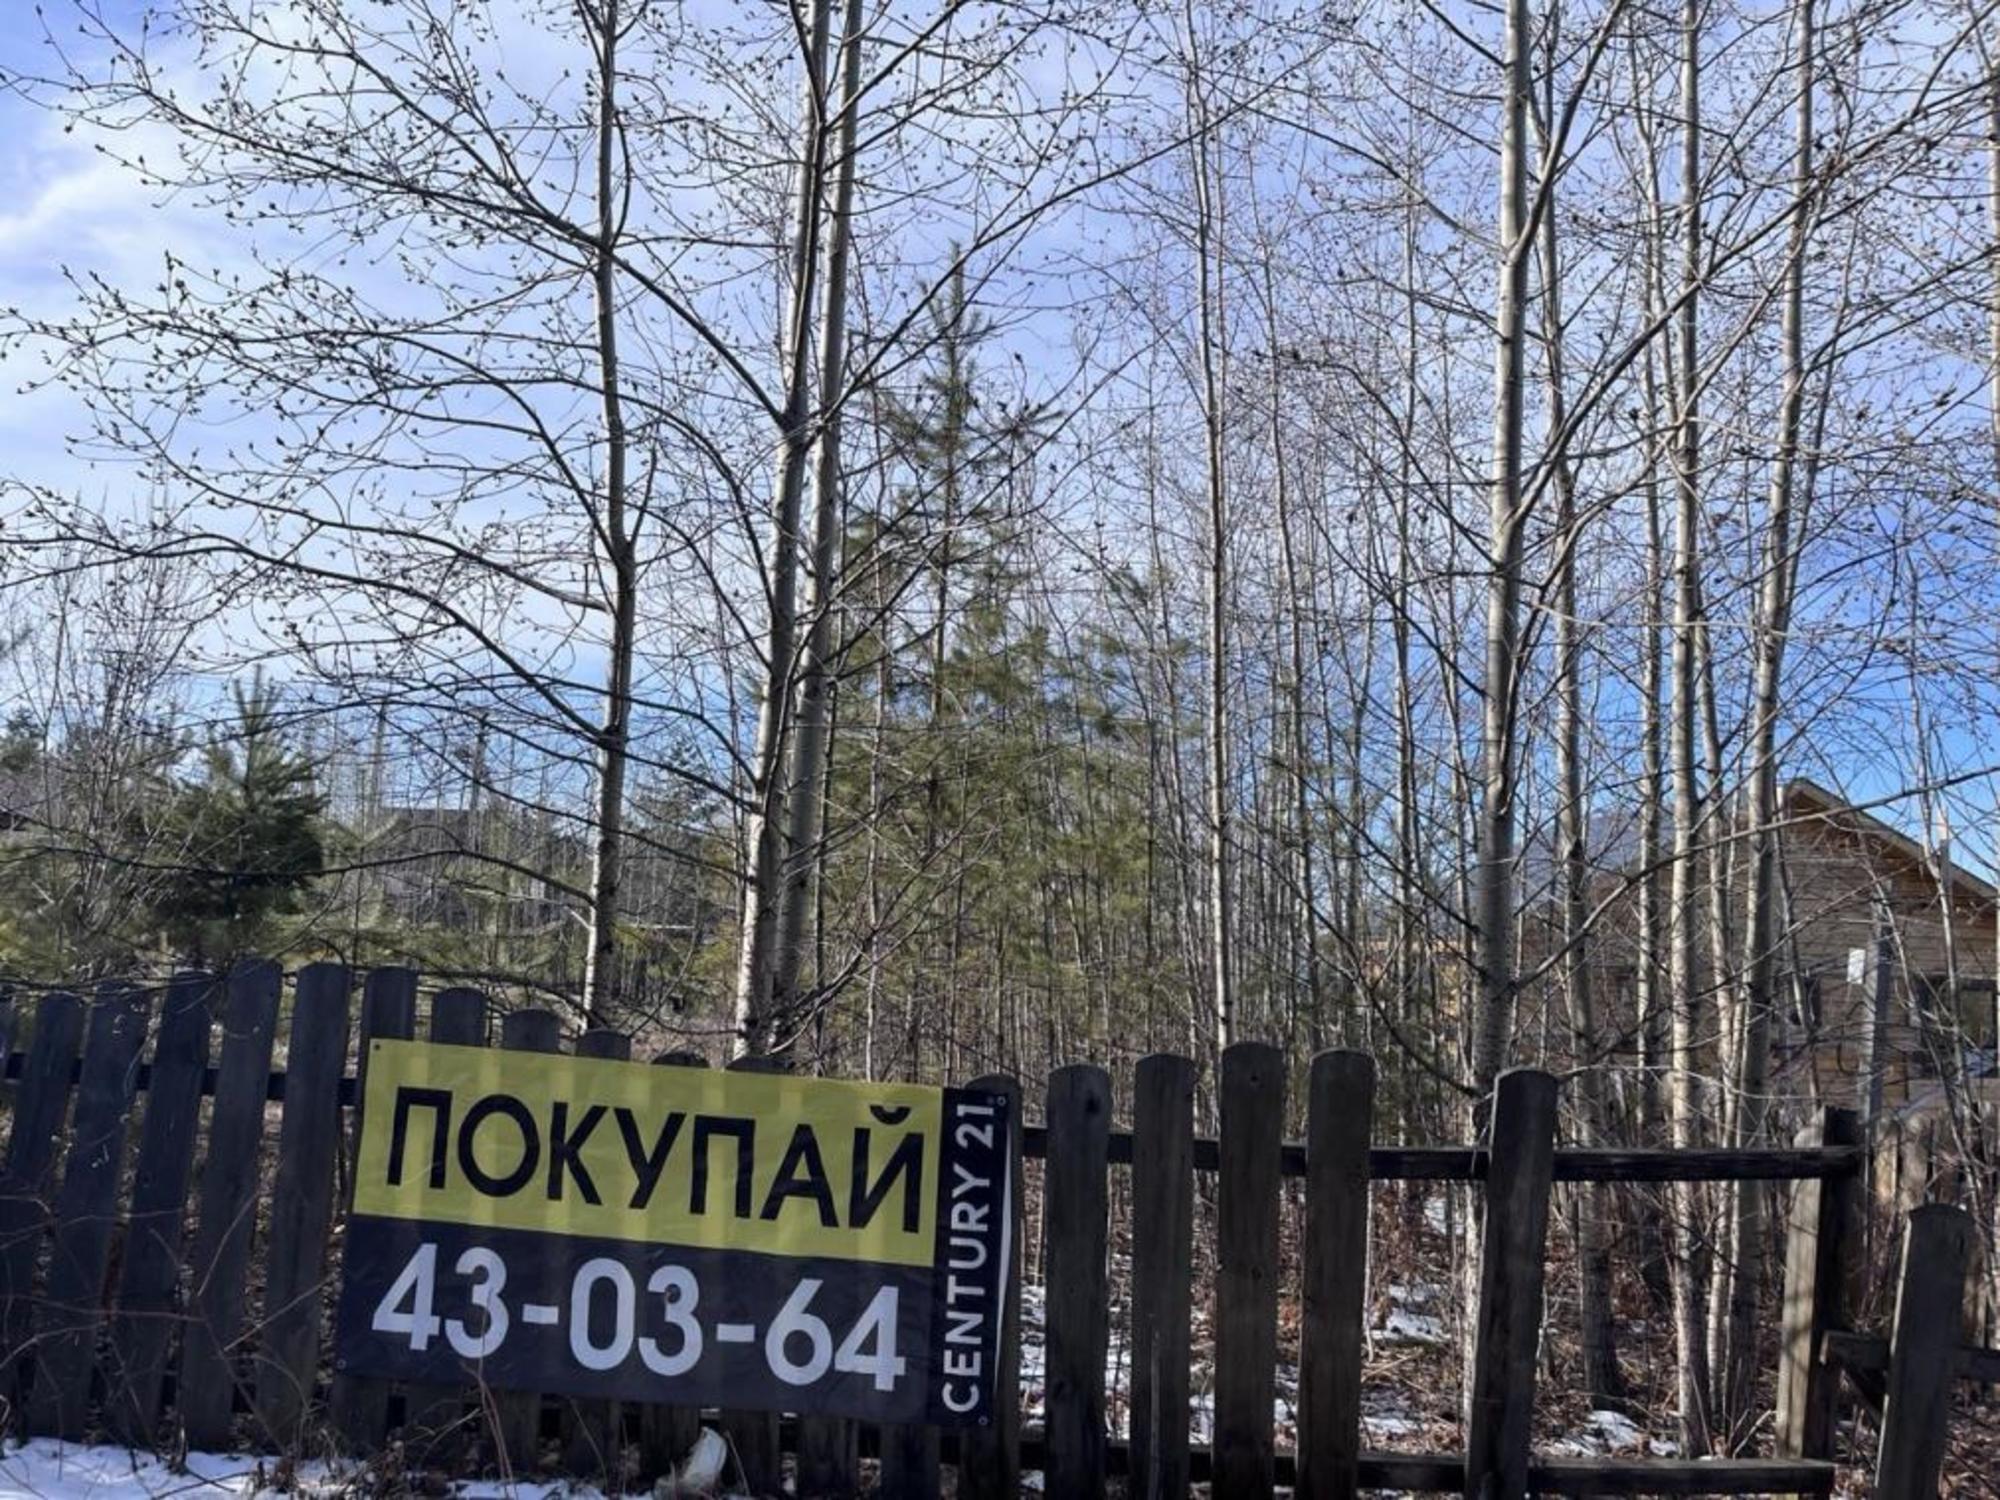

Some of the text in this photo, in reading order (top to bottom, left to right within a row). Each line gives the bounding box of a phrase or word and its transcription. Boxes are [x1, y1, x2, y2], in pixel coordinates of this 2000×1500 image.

[387, 1087, 925, 1233] ПОКУПАЙ
[372, 1243, 905, 1391] 43-03-64
[943, 1164, 991, 1413] CENTURY
